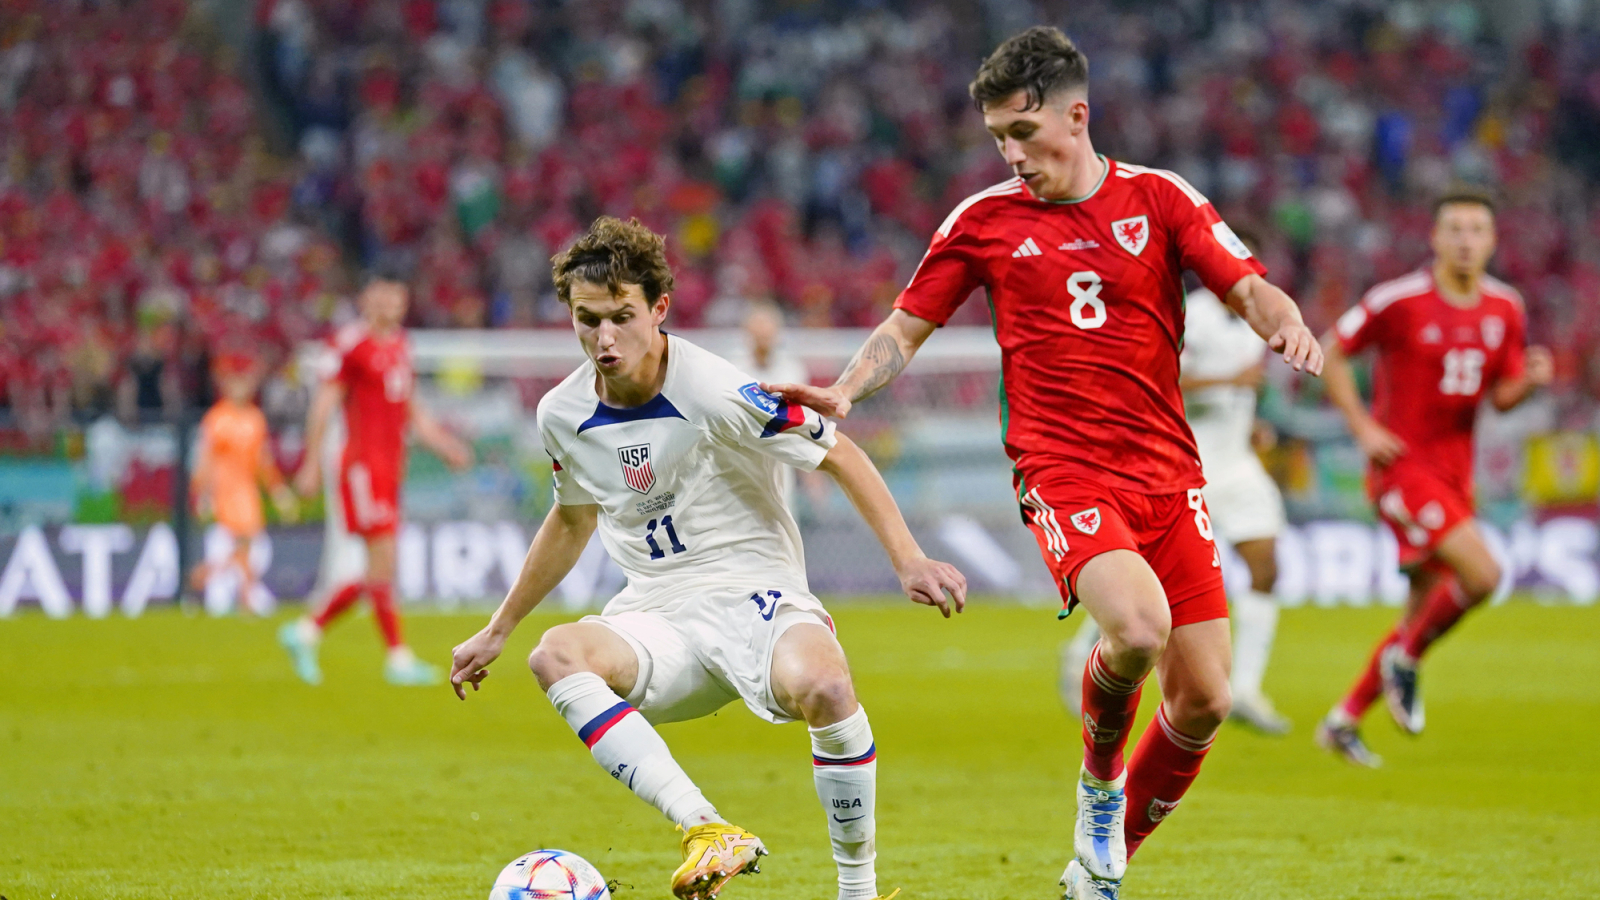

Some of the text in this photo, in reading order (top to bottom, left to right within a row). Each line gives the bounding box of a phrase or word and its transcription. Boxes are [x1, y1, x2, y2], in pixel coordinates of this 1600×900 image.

[1066, 271, 1107, 330] 8
[621, 447, 649, 468] USA
[1187, 488, 1214, 541] 8
[646, 515, 687, 560] 11
[610, 763, 628, 780] SA
[832, 798, 862, 808] USA
